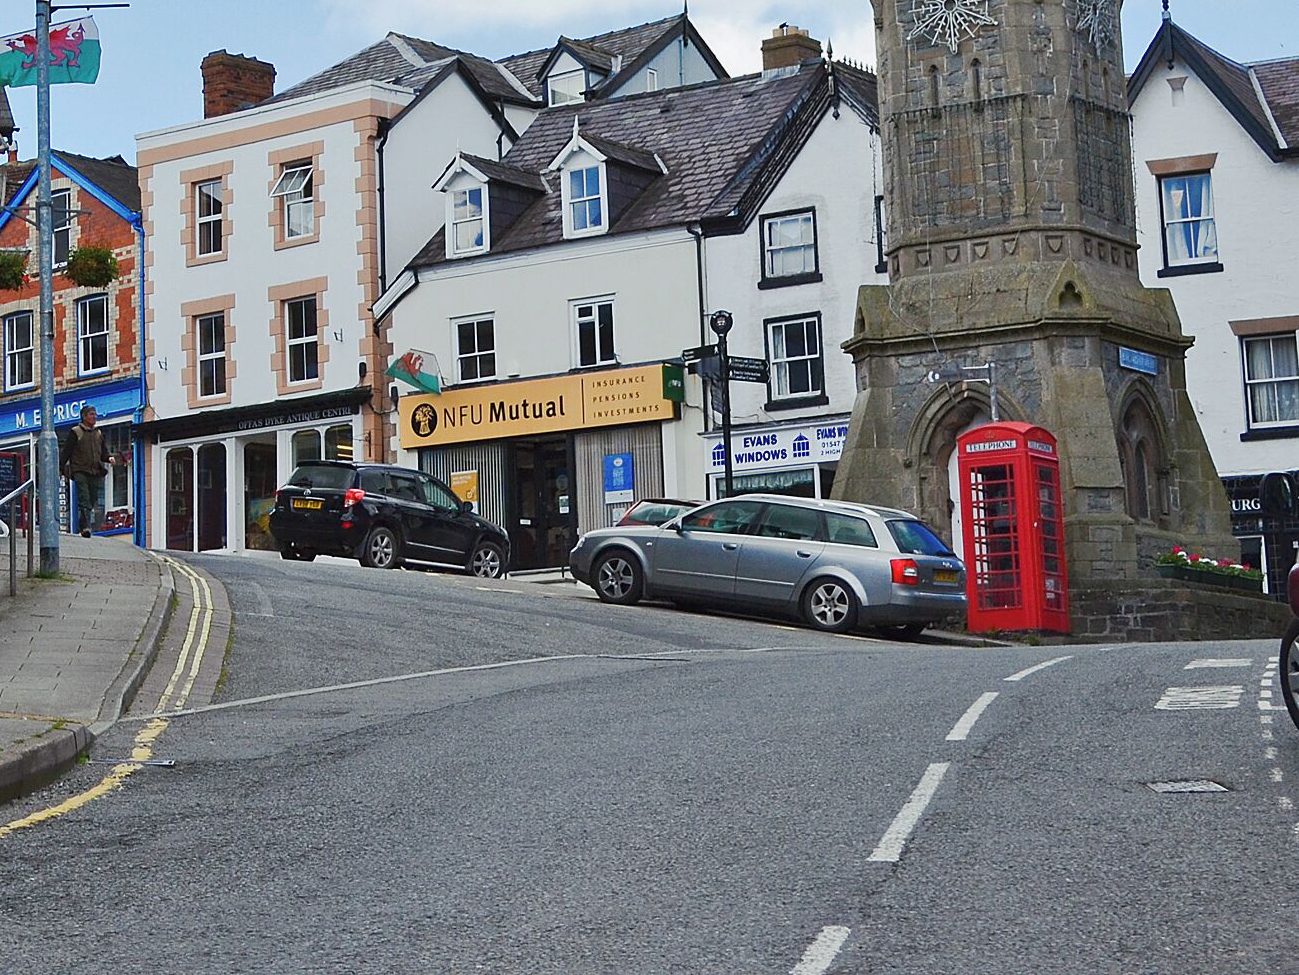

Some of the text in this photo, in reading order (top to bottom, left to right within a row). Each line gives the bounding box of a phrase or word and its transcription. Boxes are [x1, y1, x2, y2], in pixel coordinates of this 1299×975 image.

[592, 375, 646, 388] INSURANCE
[592, 391, 640, 403] PENSIONS
[264, 416, 285, 426] DYKE
[287, 411, 320, 423] ANTIQUE
[443, 395, 565, 428] NFU Mutual
[593, 404, 660, 419] INVESTMENTS
[15, 413, 28, 429] M.
[816, 426, 837, 440] EVANS
[743, 434, 777, 448] EVANS
[968, 440, 1014, 452] TELEPHONE
[735, 448, 788, 464] WINDOWS
